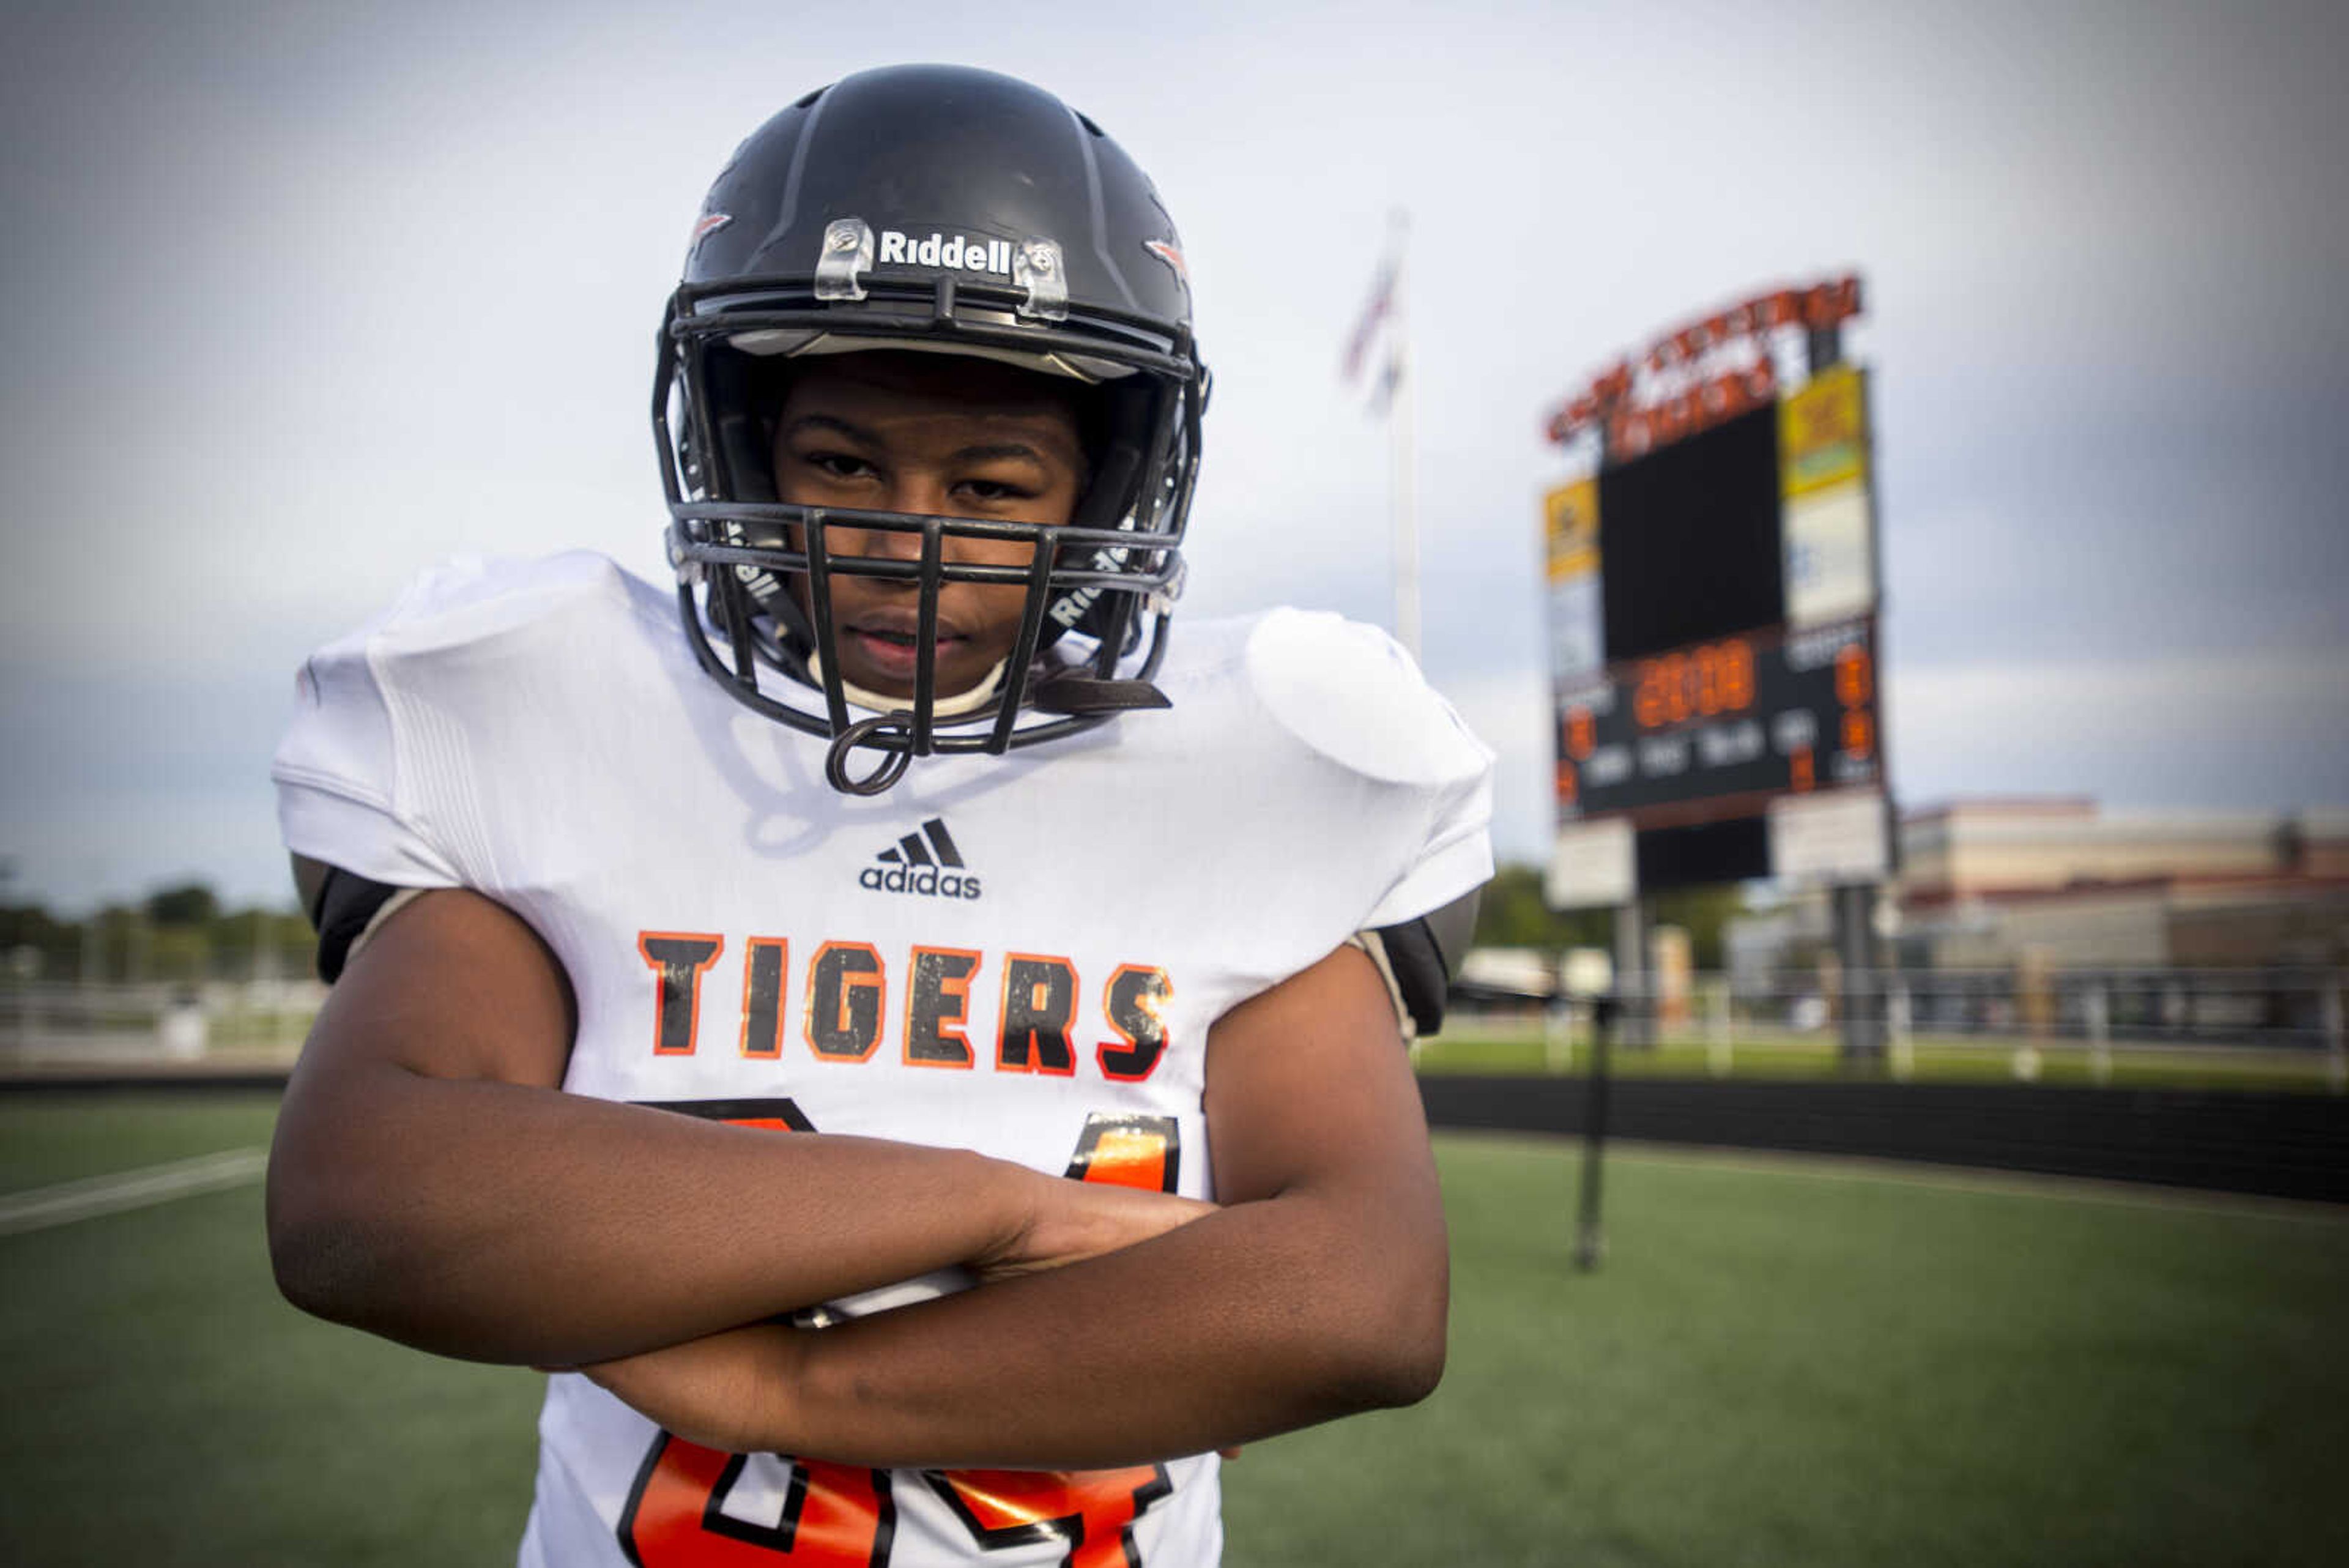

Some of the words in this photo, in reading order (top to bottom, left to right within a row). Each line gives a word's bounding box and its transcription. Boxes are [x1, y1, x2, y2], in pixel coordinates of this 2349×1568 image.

[880, 231, 1010, 274] Riddell
[859, 863, 981, 899] adidas
[637, 931, 1174, 1082] TIGERS
